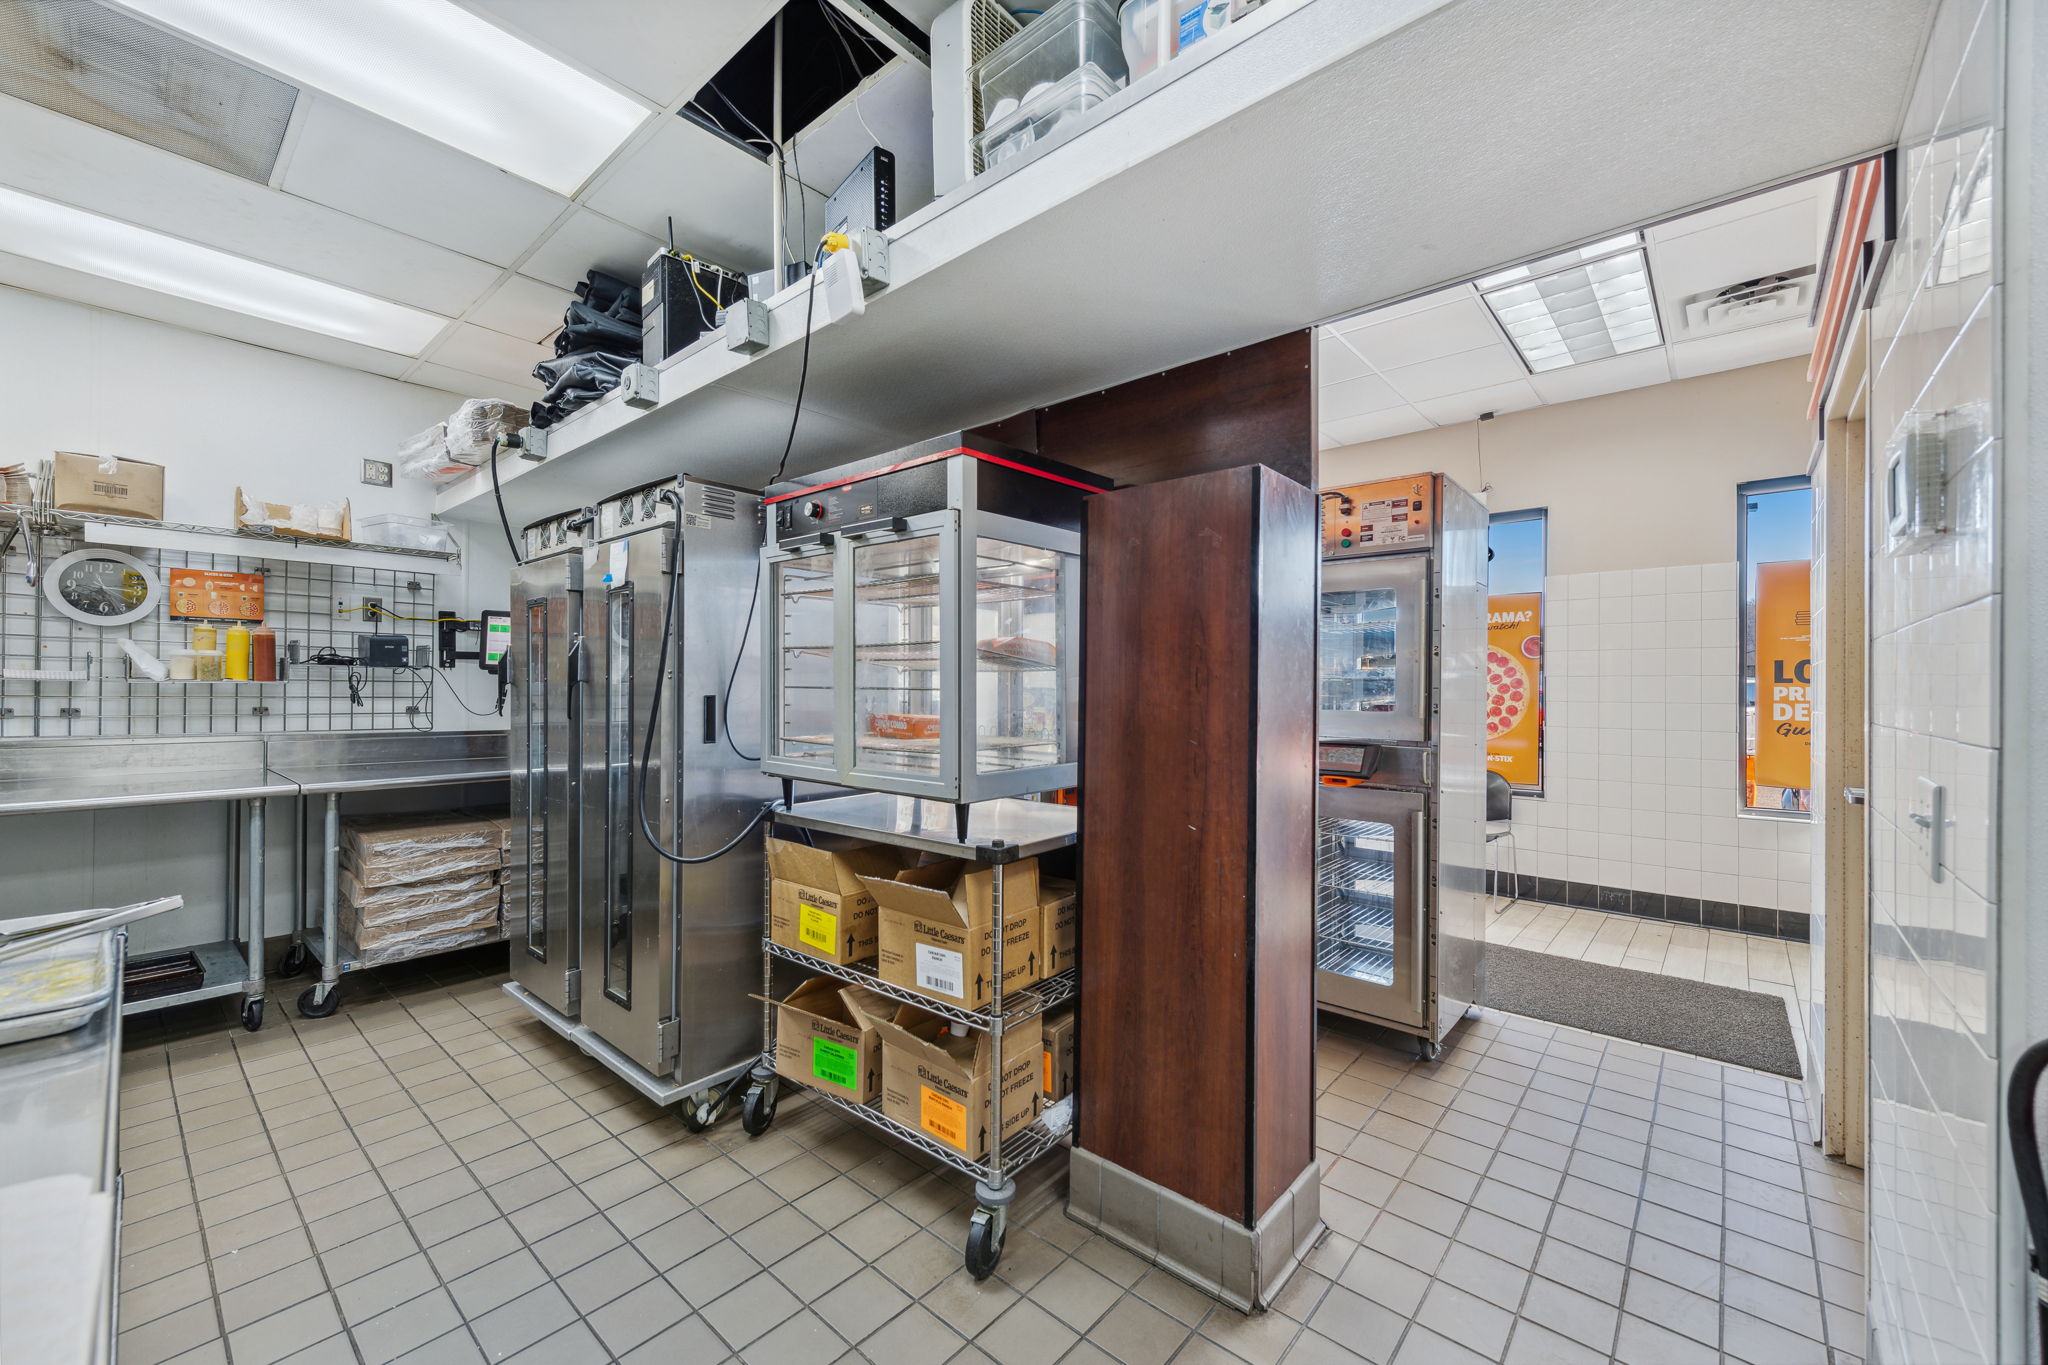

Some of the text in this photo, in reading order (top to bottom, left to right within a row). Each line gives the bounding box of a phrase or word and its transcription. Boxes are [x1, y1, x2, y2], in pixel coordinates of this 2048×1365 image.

[85, 564, 93, 573] 11
[98, 562, 114, 574] 12
[73, 570, 84, 579] 10
[131, 576, 138, 584] 2
[66, 579, 77, 591] 9
[71, 592, 78, 600] 8
[133, 586, 142, 596] 3
[83, 600, 90, 608] 7
[99, 602, 109, 613] 6
[120, 603, 126, 612] 5
[1773, 703, 1810, 722] DE
[1065, 903, 1074, 912] NO
[853, 912, 863, 920] DO
[1009, 918, 1027, 931] DROP
[923, 924, 940, 938] Little
[940, 929, 966, 945] Caesars
[981, 931, 1030, 957] DO FREEZE
[1017, 965, 1026, 975] UP
[820, 1025, 859, 1044] Little Caesars
[1013, 1060, 1031, 1076] DROP
[927, 1070, 943, 1086] Little
[943, 1079, 969, 1098] Caesars
[1010, 1073, 1034, 1093] FREEZE
[1005, 1107, 1030, 1129] SIDE UP
